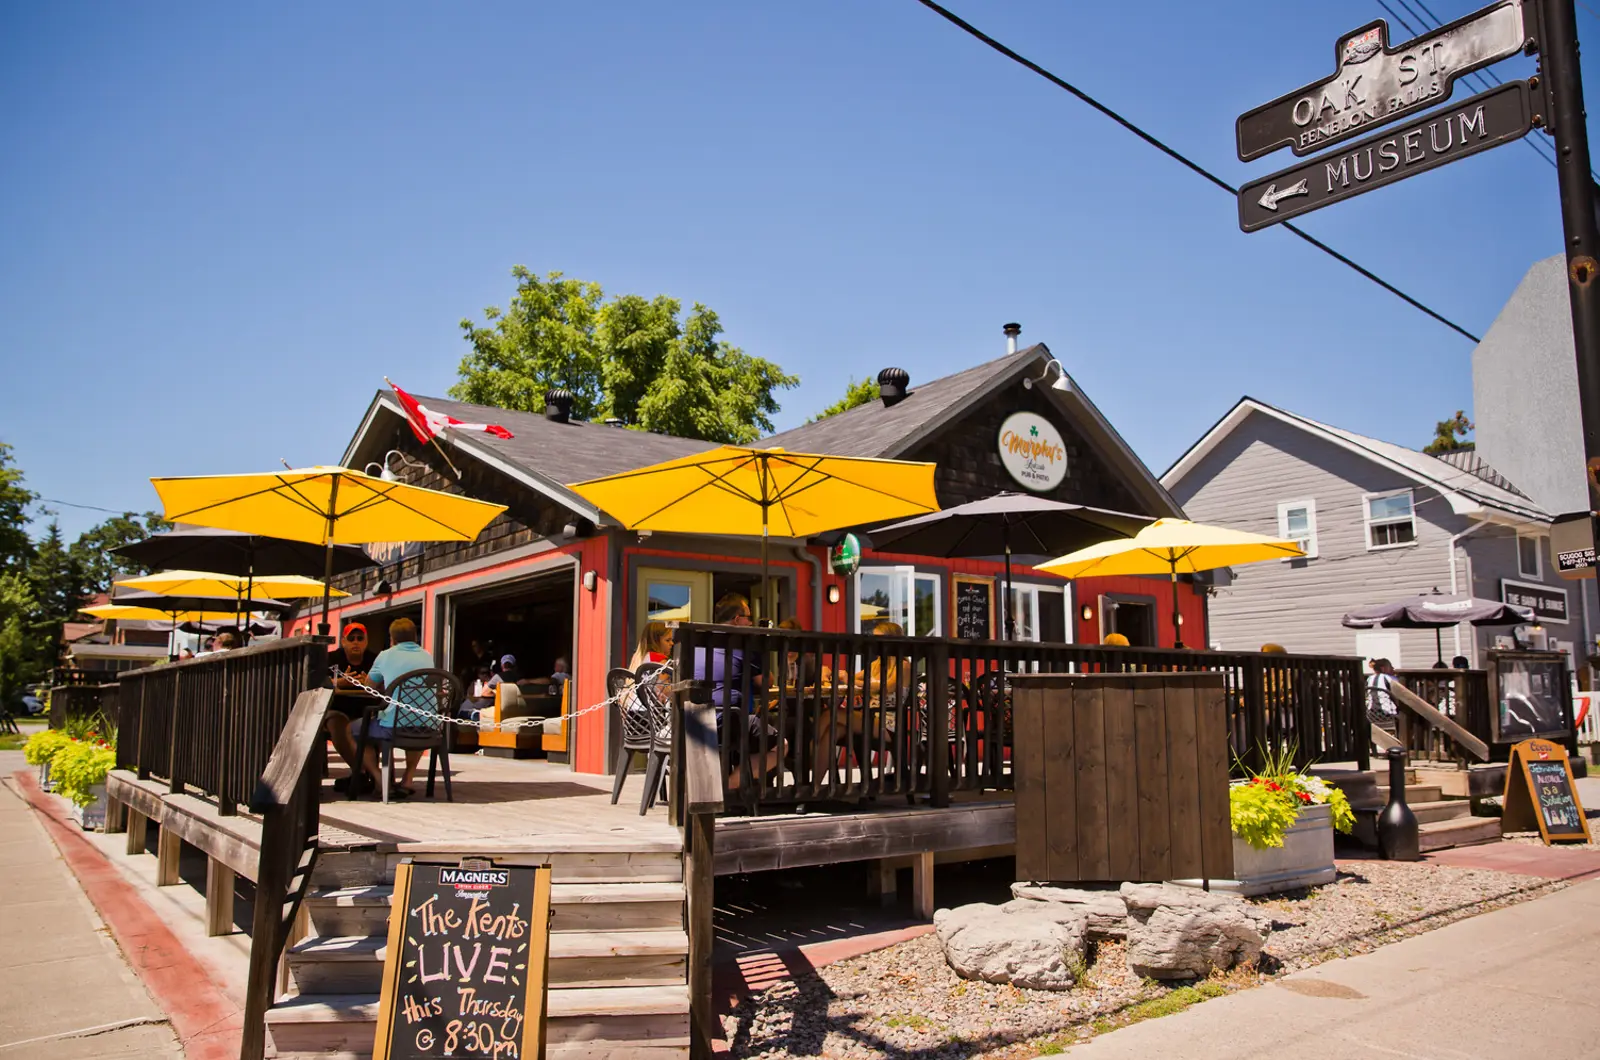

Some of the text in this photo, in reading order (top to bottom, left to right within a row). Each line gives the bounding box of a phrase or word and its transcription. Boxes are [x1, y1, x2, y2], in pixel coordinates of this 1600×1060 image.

[1292, 44, 1446, 127] OAK ST.
[1300, 84, 1440, 148] FENELON FALLS
[1325, 105, 1488, 192] MUSEUM
[1001, 430, 1063, 465] Murphy's
[1507, 593, 1520, 605] THE
[442, 870, 508, 884] MAGNERS
[411, 894, 529, 941] The Kents
[417, 942, 512, 985] LIVE
[402, 994, 444, 1025] this
[443, 1019, 519, 1060] 8:30pm
